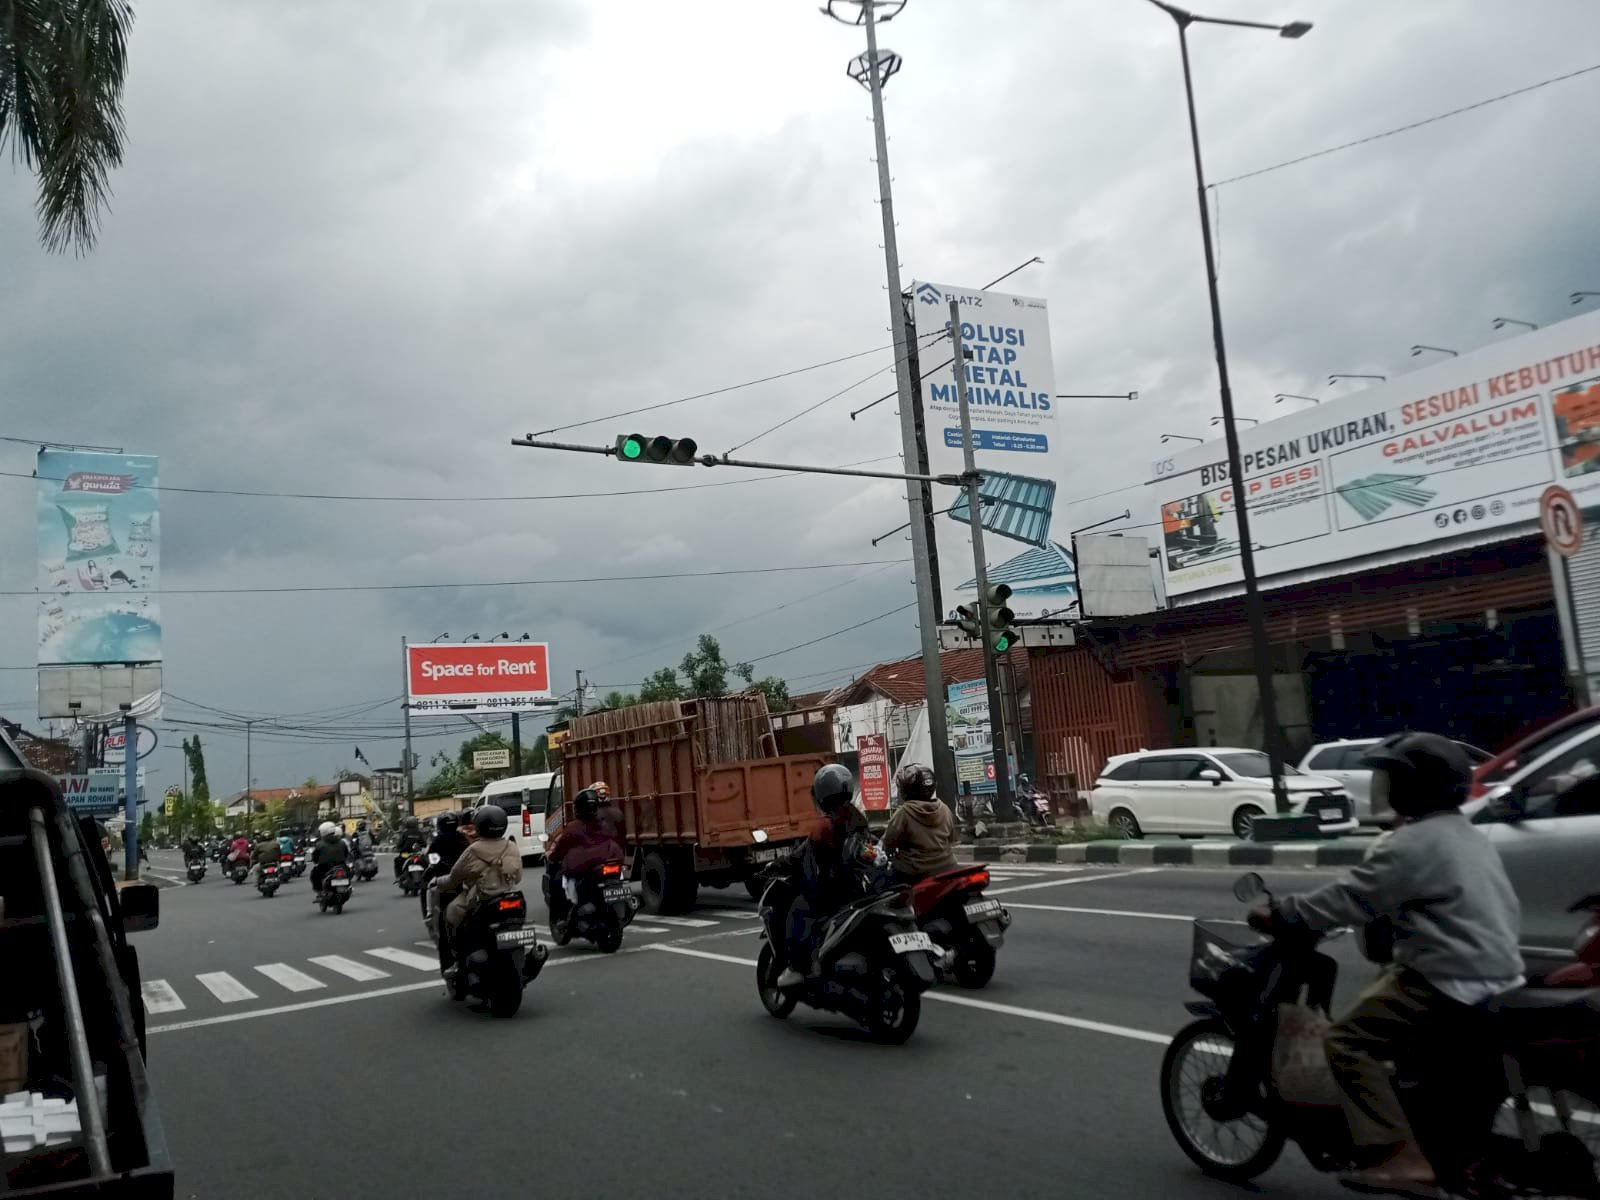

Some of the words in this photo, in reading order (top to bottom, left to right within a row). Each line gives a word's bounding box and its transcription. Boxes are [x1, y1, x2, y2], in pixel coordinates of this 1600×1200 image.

[945, 294, 983, 308] FLATZ
[1400, 382, 1481, 427] SESUAI
[1200, 462, 1233, 487] BIS
[1244, 440, 1302, 474] PESAN
[1307, 411, 1396, 455] UKURAN,
[1382, 402, 1538, 458] GALVALUM
[1220, 481, 1262, 503] CP
[1270, 465, 1319, 490] BESI
[420, 660, 474, 681] Space
[477, 662, 495, 676] for
[497, 659, 537, 676] Rent
